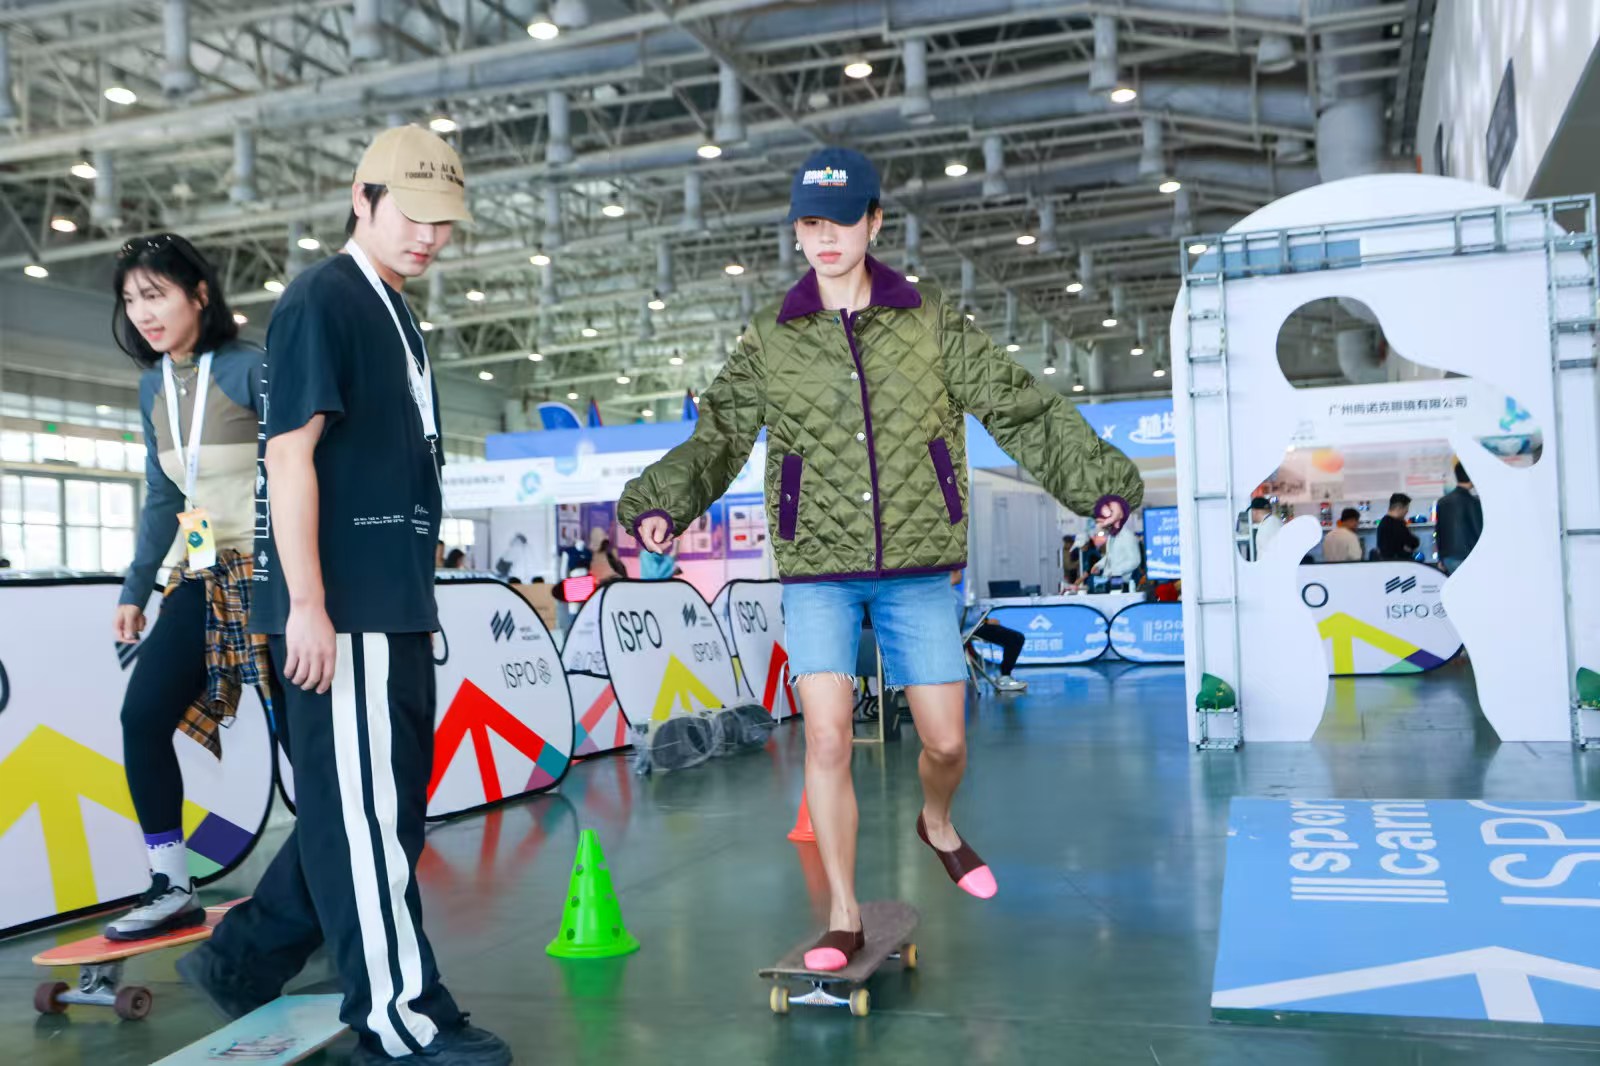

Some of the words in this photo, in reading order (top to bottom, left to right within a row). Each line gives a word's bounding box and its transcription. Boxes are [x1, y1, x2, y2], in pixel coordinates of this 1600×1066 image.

[733, 601, 767, 634] ISPO
[1387, 603, 1429, 619] ISPO
[611, 610, 662, 652] ISPO
[501, 660, 537, 688] ISPO
